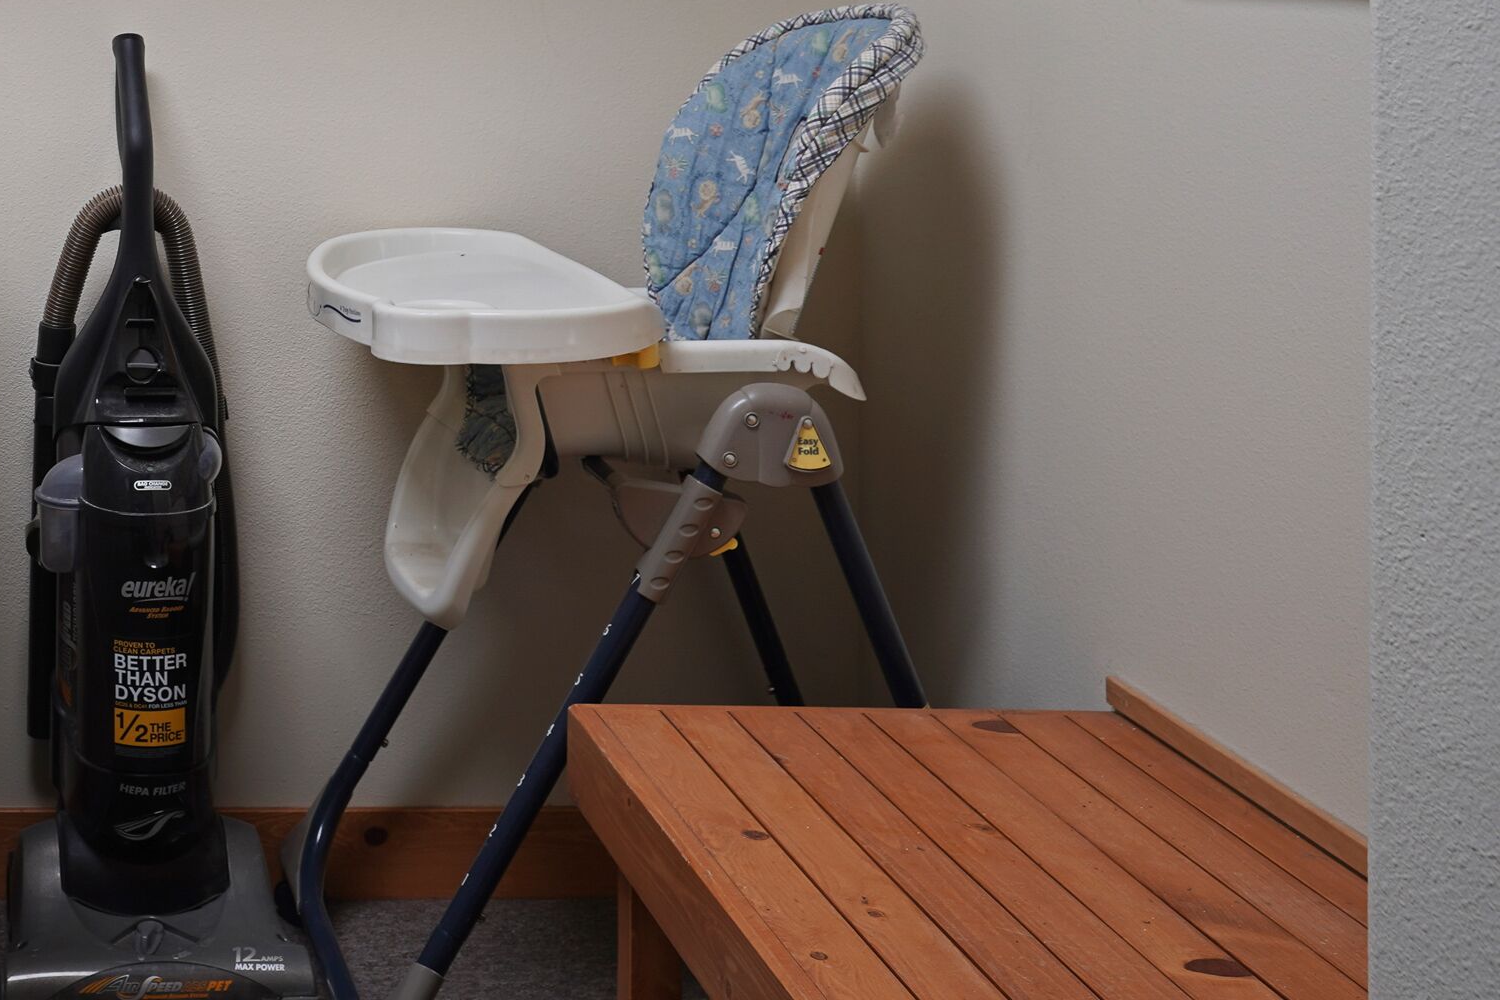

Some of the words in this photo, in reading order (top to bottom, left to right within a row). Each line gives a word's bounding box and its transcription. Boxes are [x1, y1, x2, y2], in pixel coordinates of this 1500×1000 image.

[798, 437, 819, 447] Easy
[798, 447, 820, 456] Fold
[114, 640, 144, 649] PROVEN
[113, 646, 139, 655] CLEAN
[140, 647, 176, 655] CARPETS
[114, 653, 187, 671] BETTER
[115, 668, 168, 687] THAN
[115, 683, 186, 703] DYSON
[149, 722, 171, 733] THE
[120, 783, 149, 796] HEPA
[153, 781, 186, 796] FILTER
[232, 946, 261, 963] 12
[234, 963, 254, 971] MAX
[255, 963, 286, 972] POWER
[206, 980, 233, 991] PET
